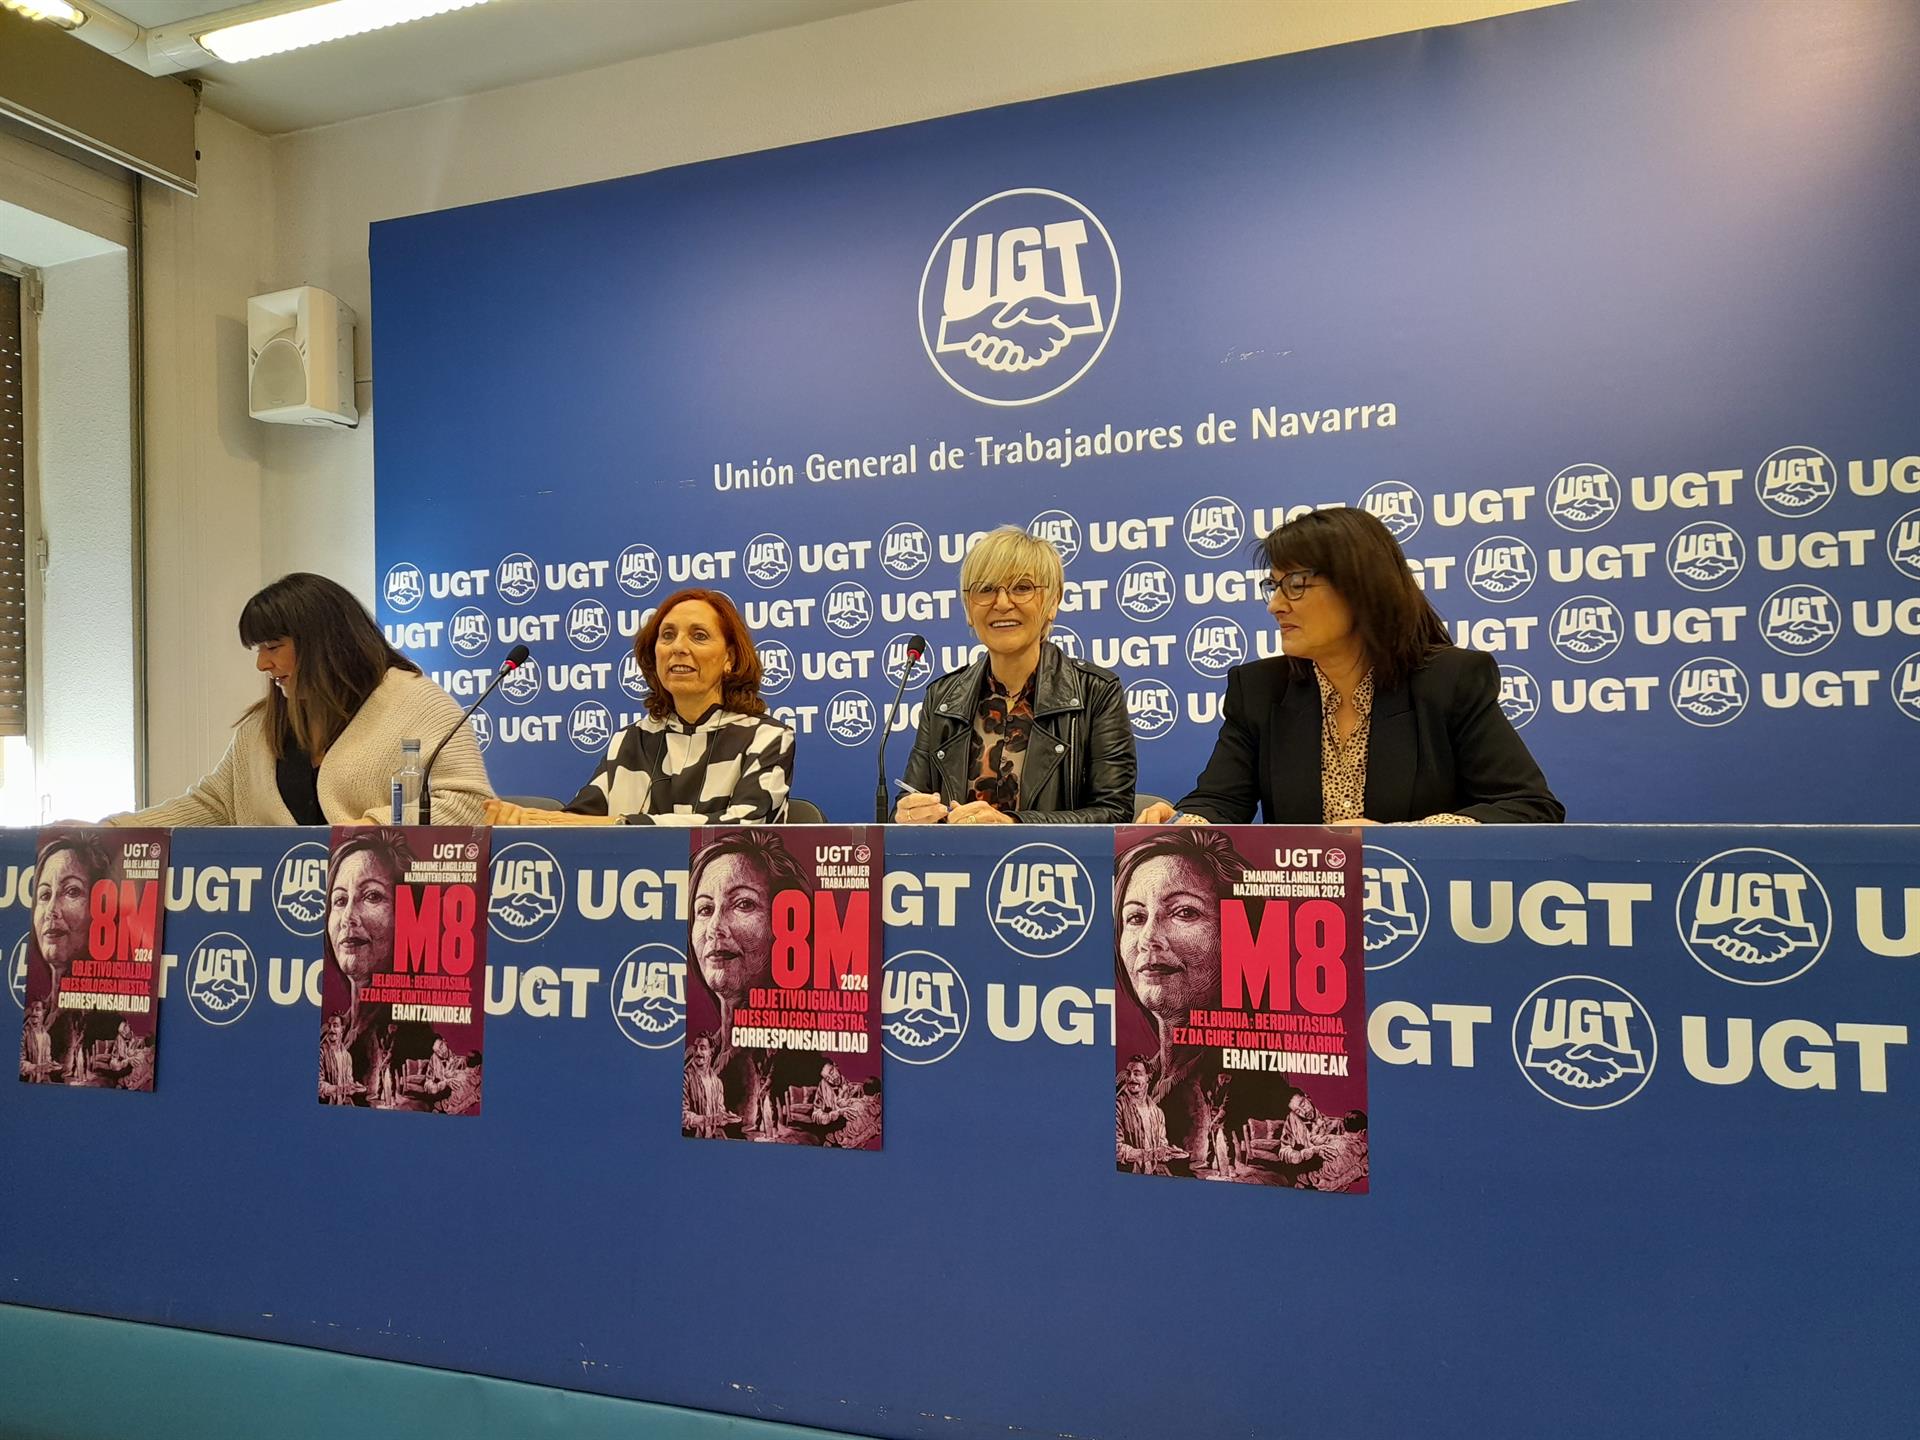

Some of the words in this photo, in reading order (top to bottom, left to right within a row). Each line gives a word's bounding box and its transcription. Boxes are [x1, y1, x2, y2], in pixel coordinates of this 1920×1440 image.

[943, 219, 1095, 317] UGT
[713, 457, 794, 491] Unión
[805, 444, 917, 483] General
[929, 441, 964, 472] de
[975, 423, 1184, 468] Trabajadores
[1196, 413, 1237, 445] de
[1252, 402, 1397, 440] Navarra
[389, 569, 419, 590] UGT
[429, 569, 490, 599] UGT
[502, 561, 533, 583] UGT
[545, 560, 610, 591] UGT
[621, 552, 655, 575] UGT
[668, 551, 736, 582] UGT
[753, 542, 785, 565] UGT
[798, 540, 872, 573] UGT
[889, 531, 924, 556] UGT
[1033, 519, 1073, 545] UGT
[1089, 516, 1175, 552] UGT
[1192, 506, 1236, 533] UGT
[1365, 491, 1414, 519] UGT
[1433, 486, 1535, 527] UGT
[1558, 474, 1609, 504] UGT
[1631, 469, 1744, 511] UGT
[1768, 456, 1825, 487] UGT
[384, 621, 444, 650] UGT
[453, 614, 485, 636] UGT
[497, 614, 560, 643] UGT
[570, 607, 605, 630] UGT
[744, 598, 816, 630] UGT
[831, 590, 866, 613] UGT
[881, 590, 957, 623] UGT
[1060, 580, 1108, 613] GT
[1122, 570, 1167, 599] UGT
[1474, 546, 1526, 573] UGT
[1548, 543, 1656, 583] UGT
[1680, 532, 1734, 561] UGT
[1758, 529, 1876, 571] UGT
[547, 663, 612, 691] UGT
[758, 649, 788, 671] GT
[801, 650, 875, 681] UGT
[1092, 635, 1177, 669] UGT
[1194, 626, 1239, 654] UGT
[1561, 606, 1613, 636] UGT
[1635, 605, 1747, 645] UGT
[1771, 596, 1829, 627] UGT
[499, 715, 562, 743] UGT
[574, 708, 606, 731] UGT
[834, 699, 869, 723] UGT
[1127, 688, 1170, 717] UGT
[1497, 675, 1530, 702] GT
[1551, 676, 1660, 714] UGT
[1682, 668, 1737, 698] UGT
[1762, 669, 1880, 709] UGT
[123, 843, 149, 858] UGT
[432, 843, 465, 859] UGT
[815, 845, 853, 863] UGT
[1275, 848, 1323, 868] UGT
[816, 863, 828, 877] DÍA
[828, 865, 837, 877] DE
[837, 865, 846, 877] LA
[847, 865, 870, 877] MUJER
[1243, 870, 1286, 883] EMAKUME
[1286, 870, 1344, 884] LANGILEAREN
[820, 877, 869, 889] TRABAJADORA
[1233, 883, 1291, 897] NAZIOARTEKO
[1291, 884, 1320, 897] EGUNA
[1321, 885, 1345, 898] 2024
[166, 867, 262, 913] UGT
[490, 860, 553, 897] UGT
[882, 870, 971, 928] GT
[1000, 863, 1078, 905] UGT
[1363, 868, 1409, 916] GT
[1449, 880, 1652, 947] UGT
[1696, 872, 1808, 922] UGT
[88, 879, 160, 961] 8M
[393, 884, 476, 976] M8
[770, 889, 870, 989] 8M
[134, 948, 153, 962] 2024
[1220, 899, 1347, 1015] M8
[840, 974, 869, 991] 2024
[58, 991, 150, 1013] CORRESPONSABILIDAD
[749, 988, 806, 1010] OBJETIVO
[807, 990, 869, 1012] IGUALDAD
[199, 948, 249, 980] UGT
[484, 966, 600, 1019] UGT
[624, 961, 687, 1004] UGT
[883, 970, 956, 1014] UGT
[1367, 1000, 1492, 1069] GT
[1531, 998, 1635, 1051] UGT
[1681, 1015, 1908, 1093] UGT
[391, 1003, 472, 1024] ERANTZUNKIDEAK
[734, 1009, 748, 1026] NO
[748, 1009, 761, 1027] ES
[762, 1010, 788, 1028] SOLO
[789, 1011, 816, 1029] COSA
[817, 1012, 868, 1032] NUESTRA:
[1255, 1012, 1348, 1035] BERDINTASUNA.
[731, 1026, 869, 1054] CORRESPONSABILIDAD
[1173, 1027, 1188, 1044] EZ
[1188, 1028, 1203, 1045] DA
[1205, 1028, 1235, 1047] GURE
[1236, 1030, 1283, 1050] KONTUA
[1283, 1033, 1348, 1054] BAKARRIK.
[1222, 1047, 1348, 1077] ERANTZUNKIDEAK
